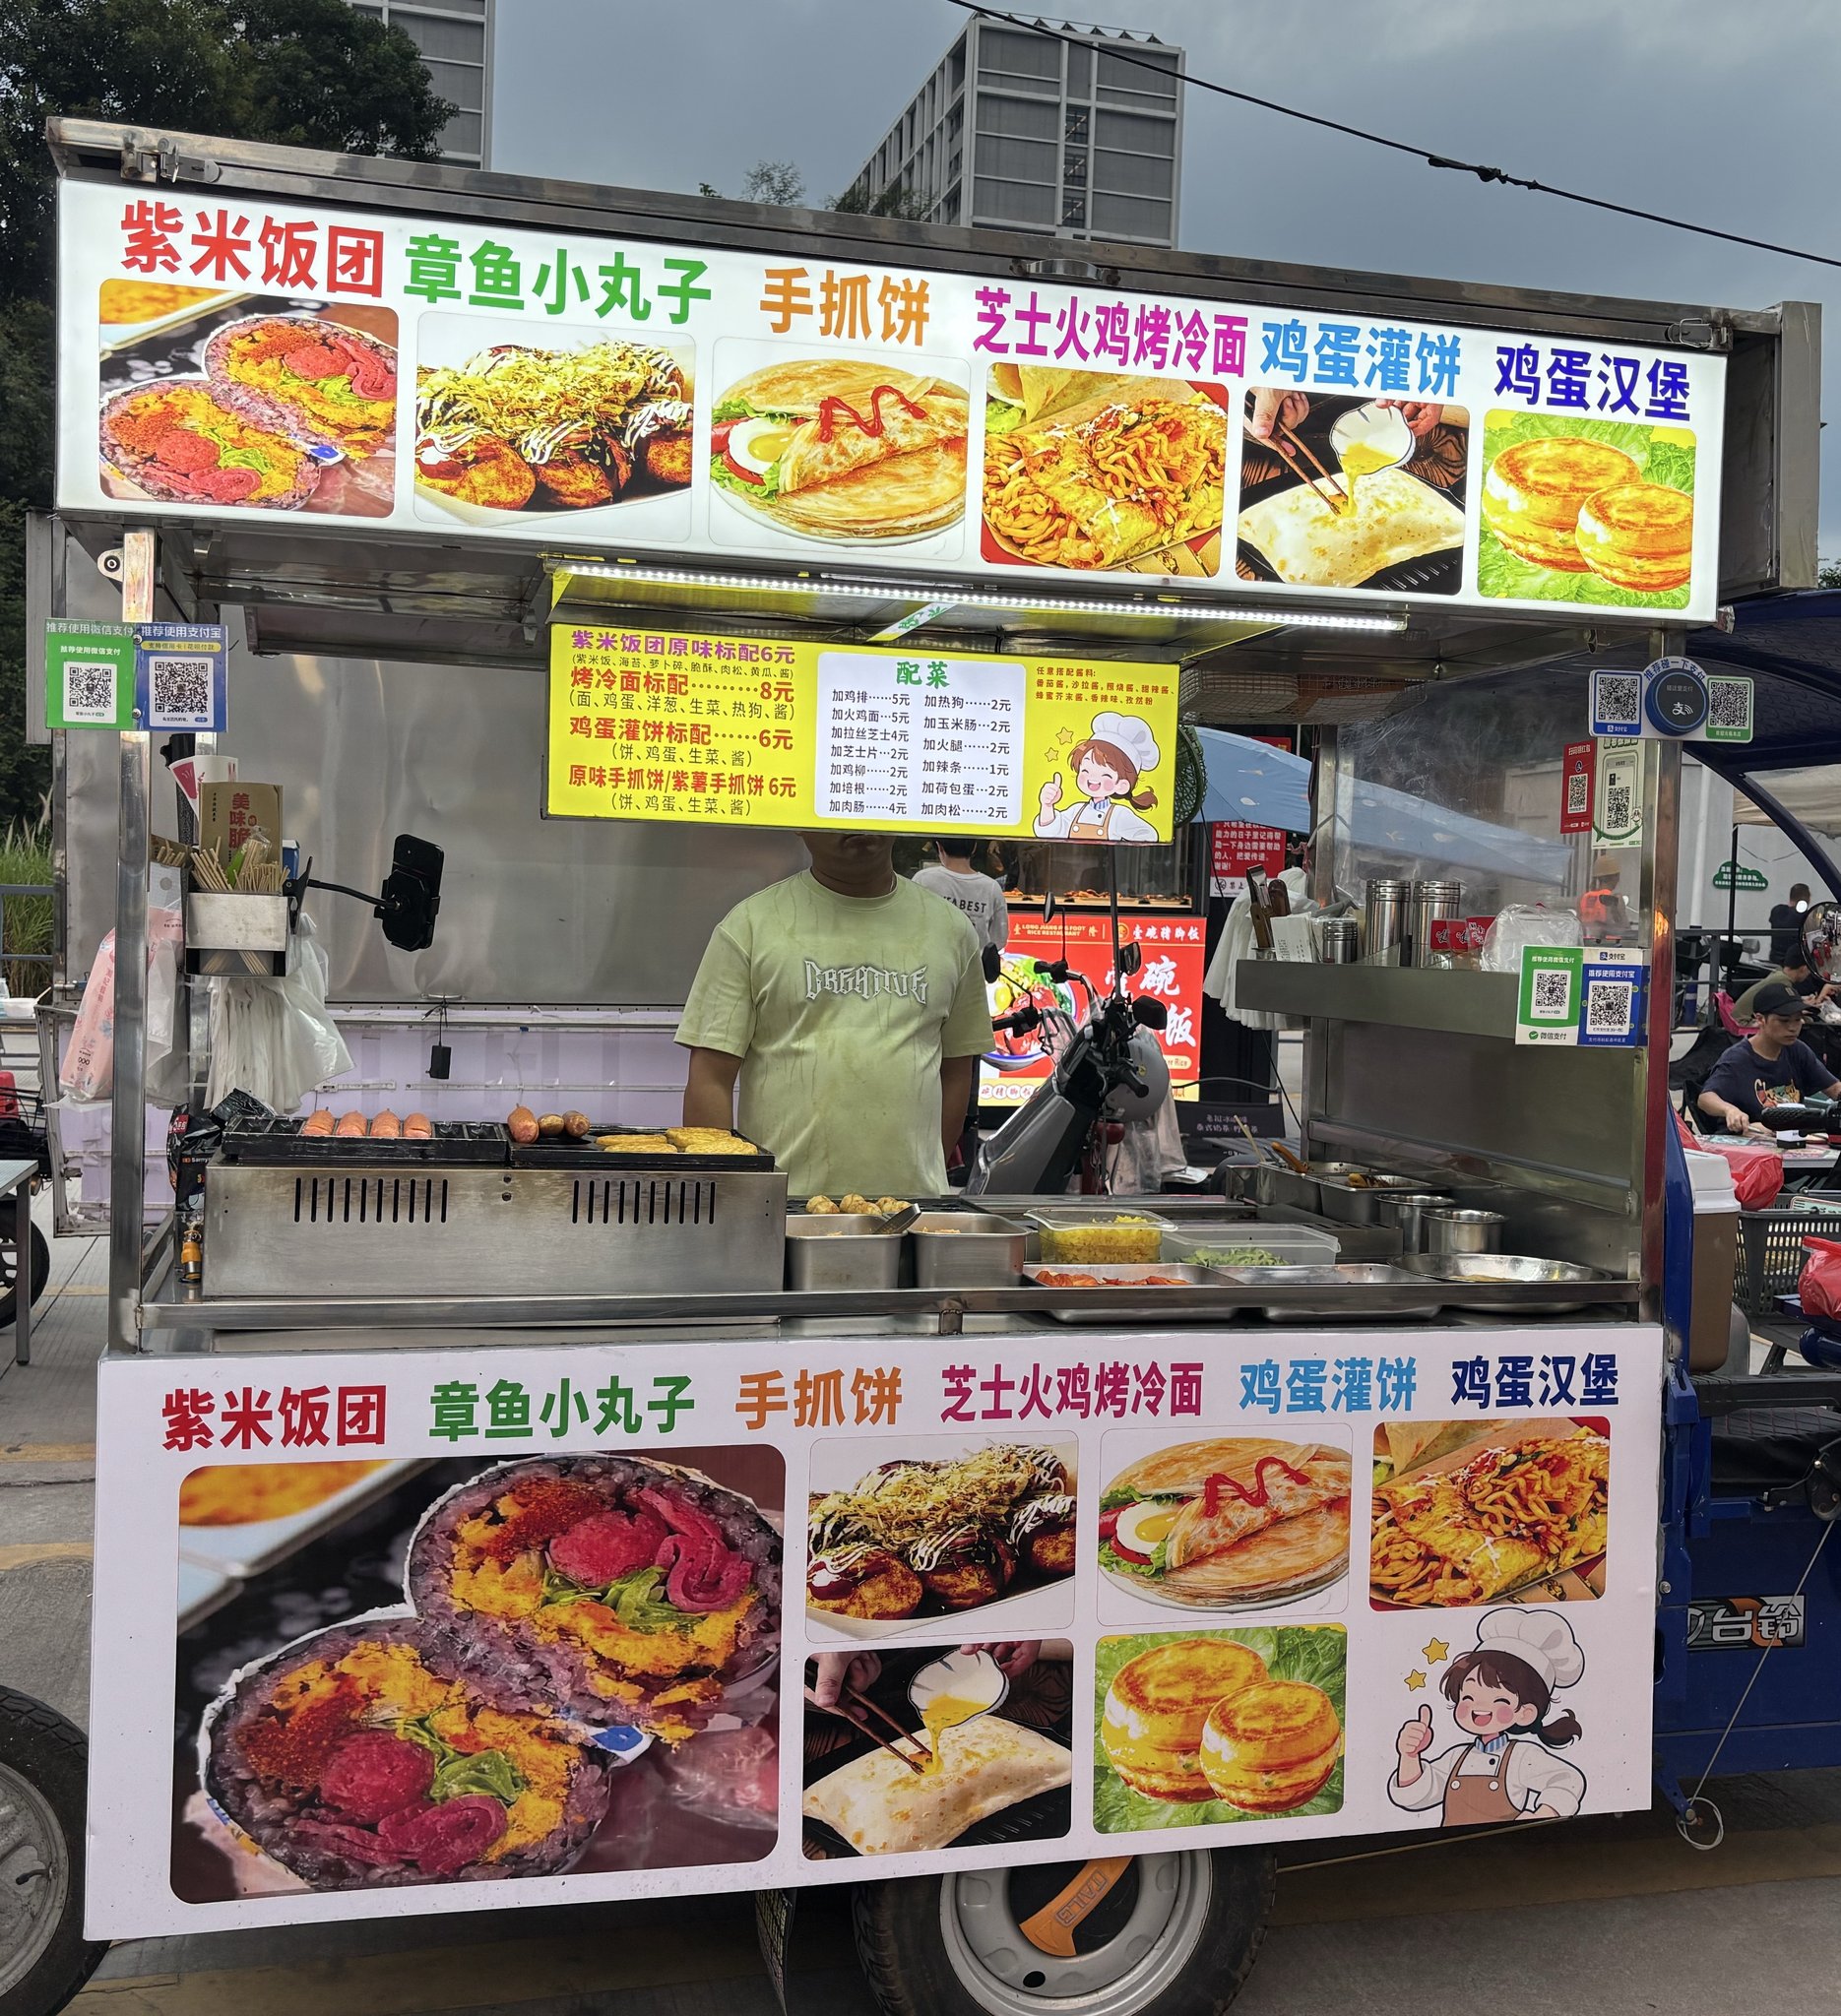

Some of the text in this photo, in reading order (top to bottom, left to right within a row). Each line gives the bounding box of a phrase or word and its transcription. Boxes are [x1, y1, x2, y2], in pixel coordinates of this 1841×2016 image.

[120, 200, 1690, 421] 紫米饭团 章鱼小丸子 手抓饼 芝士火鸡烤冷面 鸡蛋灌饼 鸡蛋汉堡
[46, 622, 134, 638] 推荐使用微信支付
[141, 625, 222, 639] 推荐使用支付宝
[60, 645, 121, 656] 推荐使用微信支付
[571, 630, 795, 665] 紫米饭团原味标配6元
[896, 661, 950, 689] 配菜
[1644, 659, 1705, 680] 推荐碰一下支付
[831, 726, 910, 742] 加拉丝芝士4元
[1541, 1032, 1567, 1040] 微信支付
[161, 1353, 1619, 1452] 紫米饭团 章鱼小丸子 手抓饼 芝士火鸡烤冷面 鸡蛋灌饼 鸡蛋汉堡
[1712, 1604, 1802, 1642] 台铃
